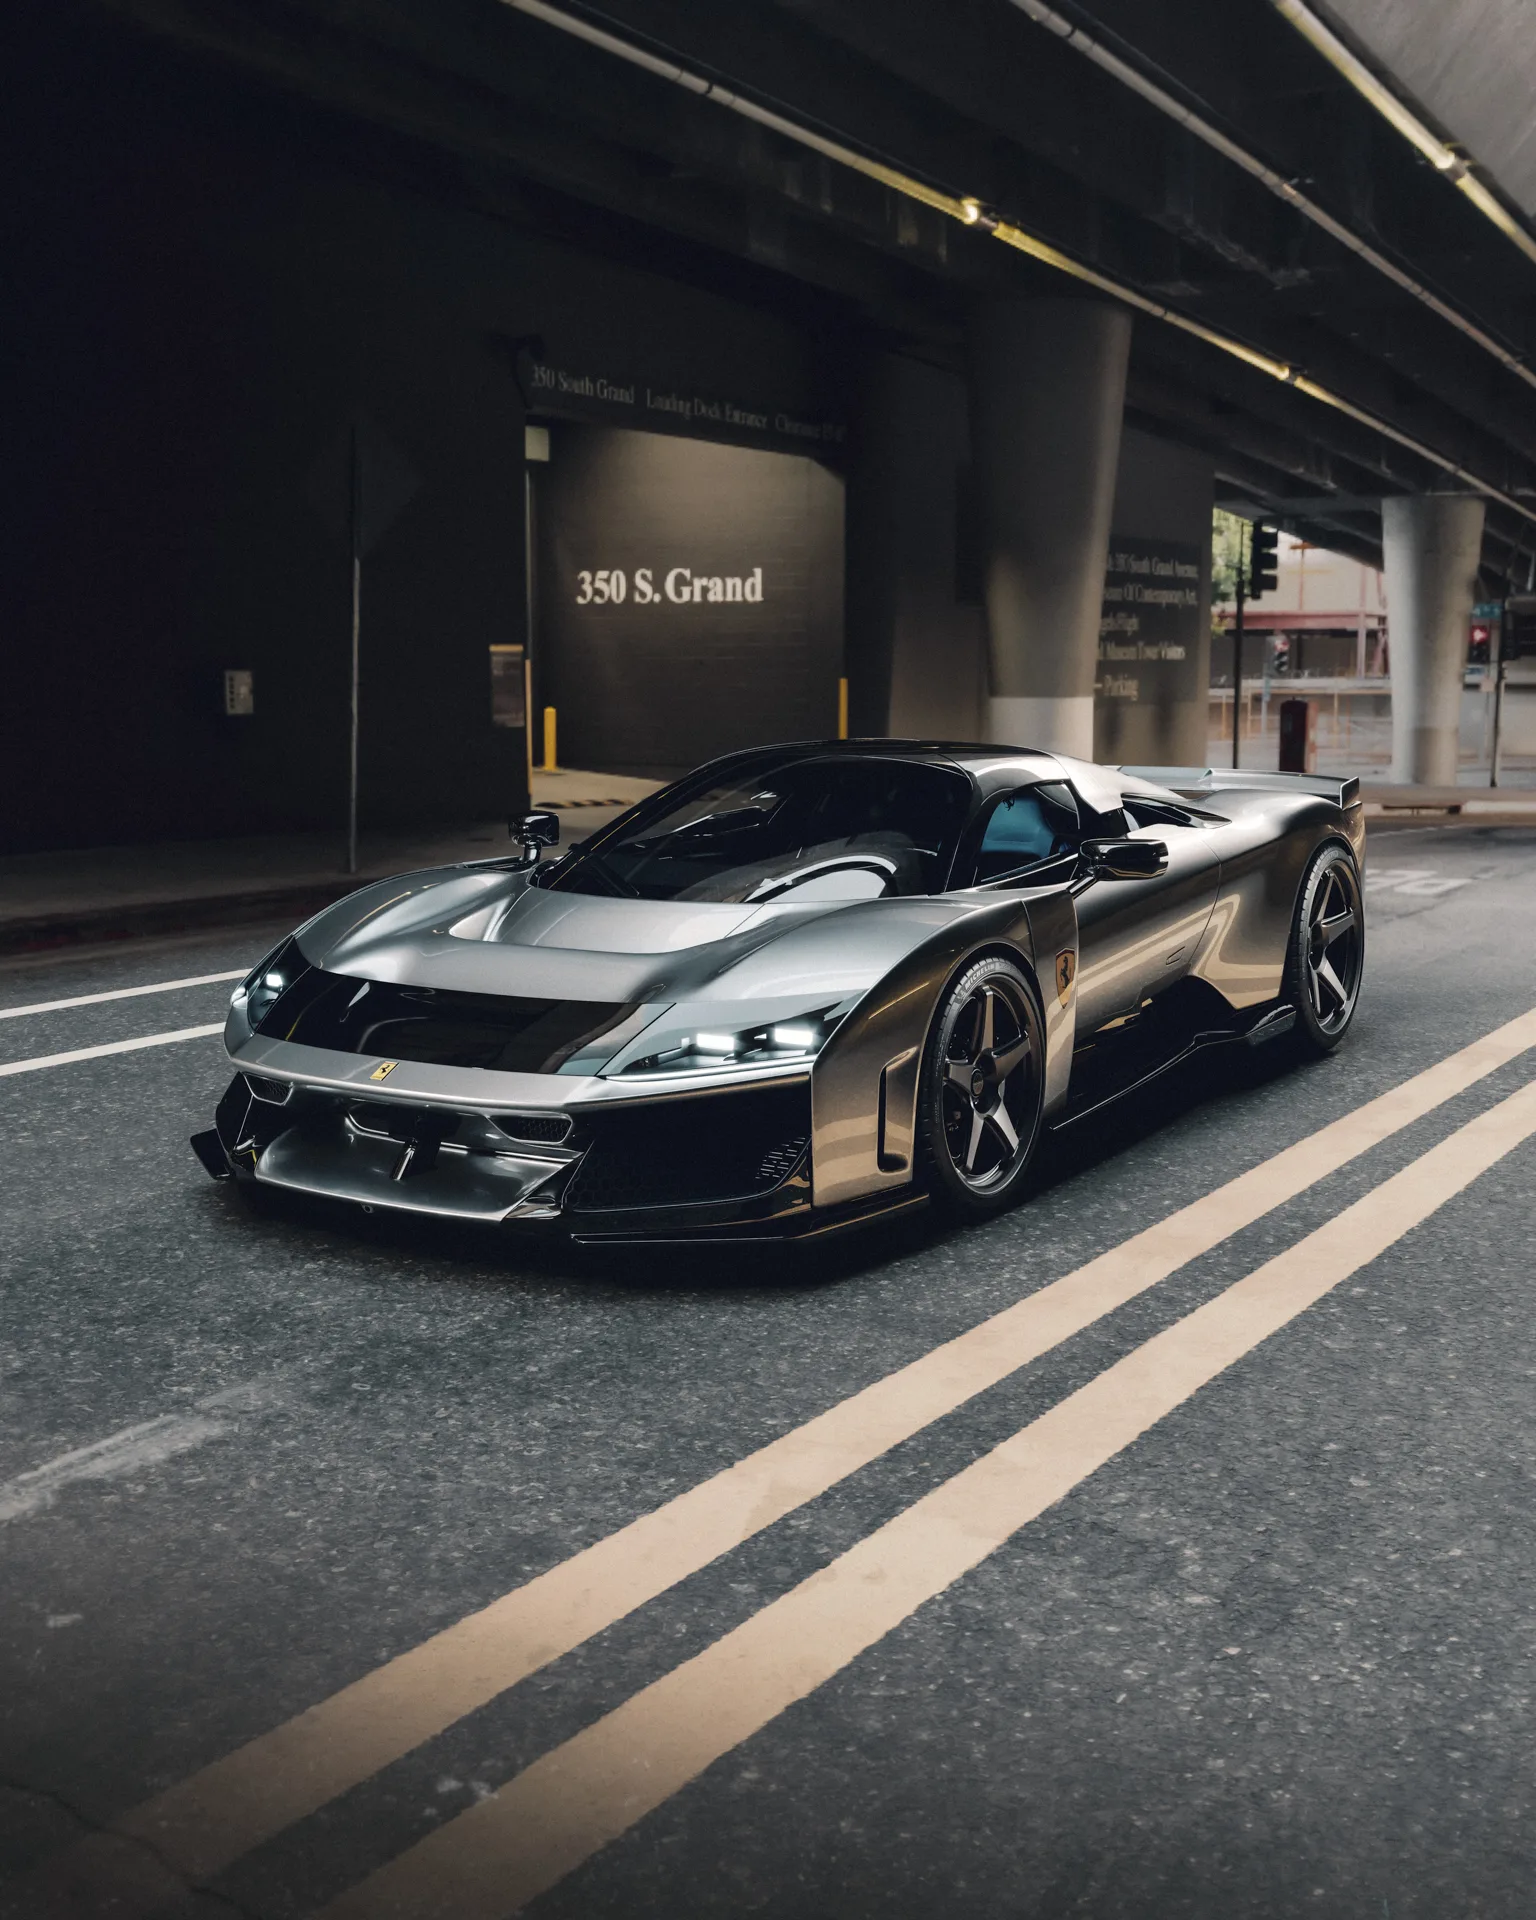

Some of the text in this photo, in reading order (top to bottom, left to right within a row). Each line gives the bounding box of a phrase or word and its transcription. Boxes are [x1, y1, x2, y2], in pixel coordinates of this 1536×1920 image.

[530, 363, 555, 389] 350
[557, 370, 594, 397] South
[596, 377, 635, 404] Grand
[575, 566, 765, 604] 350 S. Grand
[964, 964, 995, 990] MICHELIN
